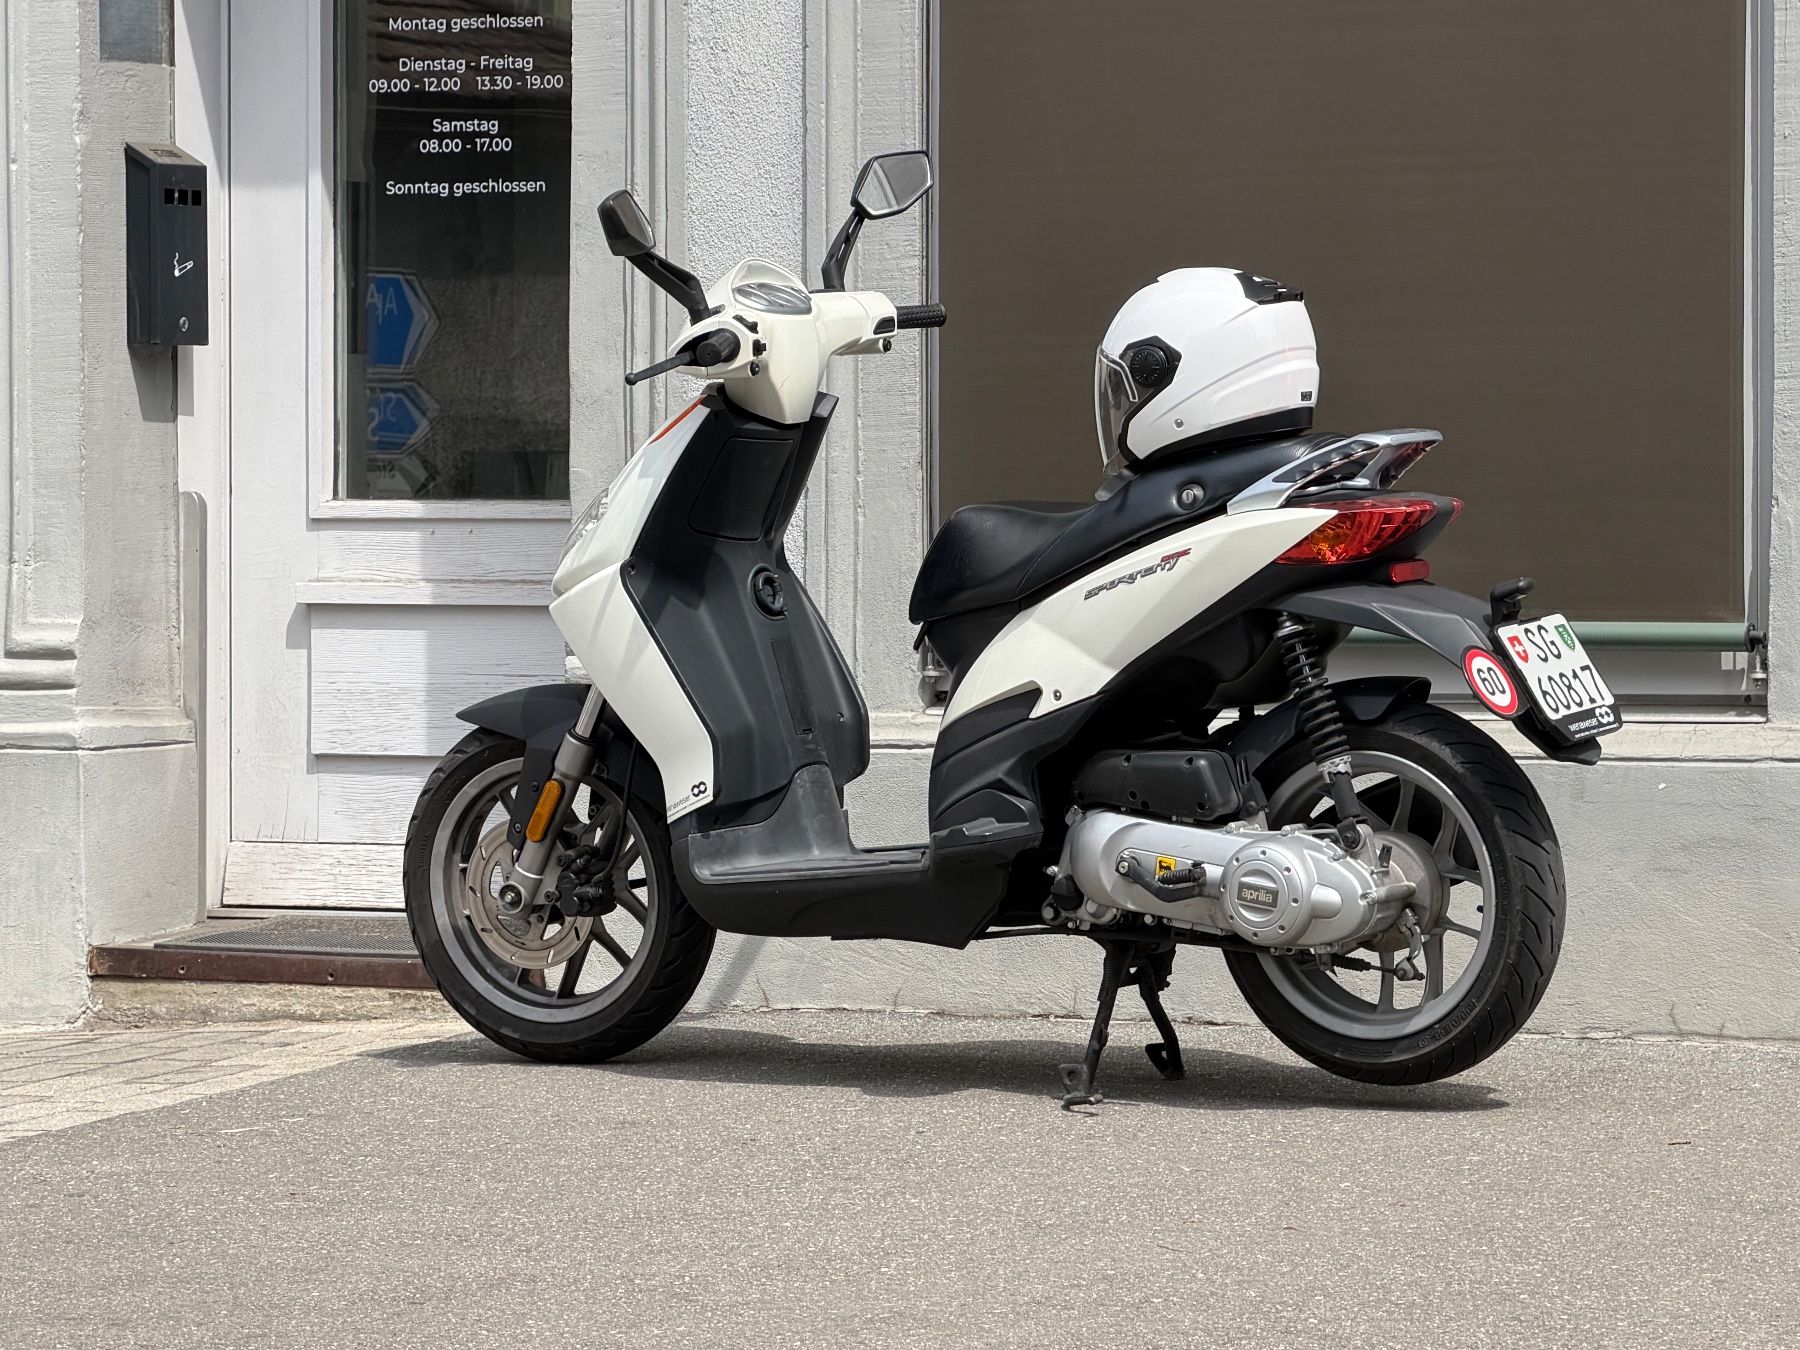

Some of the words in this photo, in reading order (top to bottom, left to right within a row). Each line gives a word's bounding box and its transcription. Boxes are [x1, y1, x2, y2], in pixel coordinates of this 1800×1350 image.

[388, 17, 447, 33] Montag
[451, 14, 544, 33] geschlossen
[399, 57, 466, 73] Dienstag
[480, 54, 533, 71] Freitag
[368, 78, 411, 93] 09.00
[423, 77, 461, 92] 12.00
[476, 76, 513, 90] 13.30
[526, 74, 564, 90] 19.00
[432, 118, 499, 134] Samstag
[419, 138, 462, 153] 08.00
[474, 137, 512, 152] 17.00
[385, 180, 449, 197] Sonntag
[453, 178, 546, 197] geschlossen
[1523, 624, 1562, 663] SG
[1476, 666, 1507, 697] 60
[1537, 664, 1605, 714] 60817
[1241, 888, 1273, 903] aprilia
